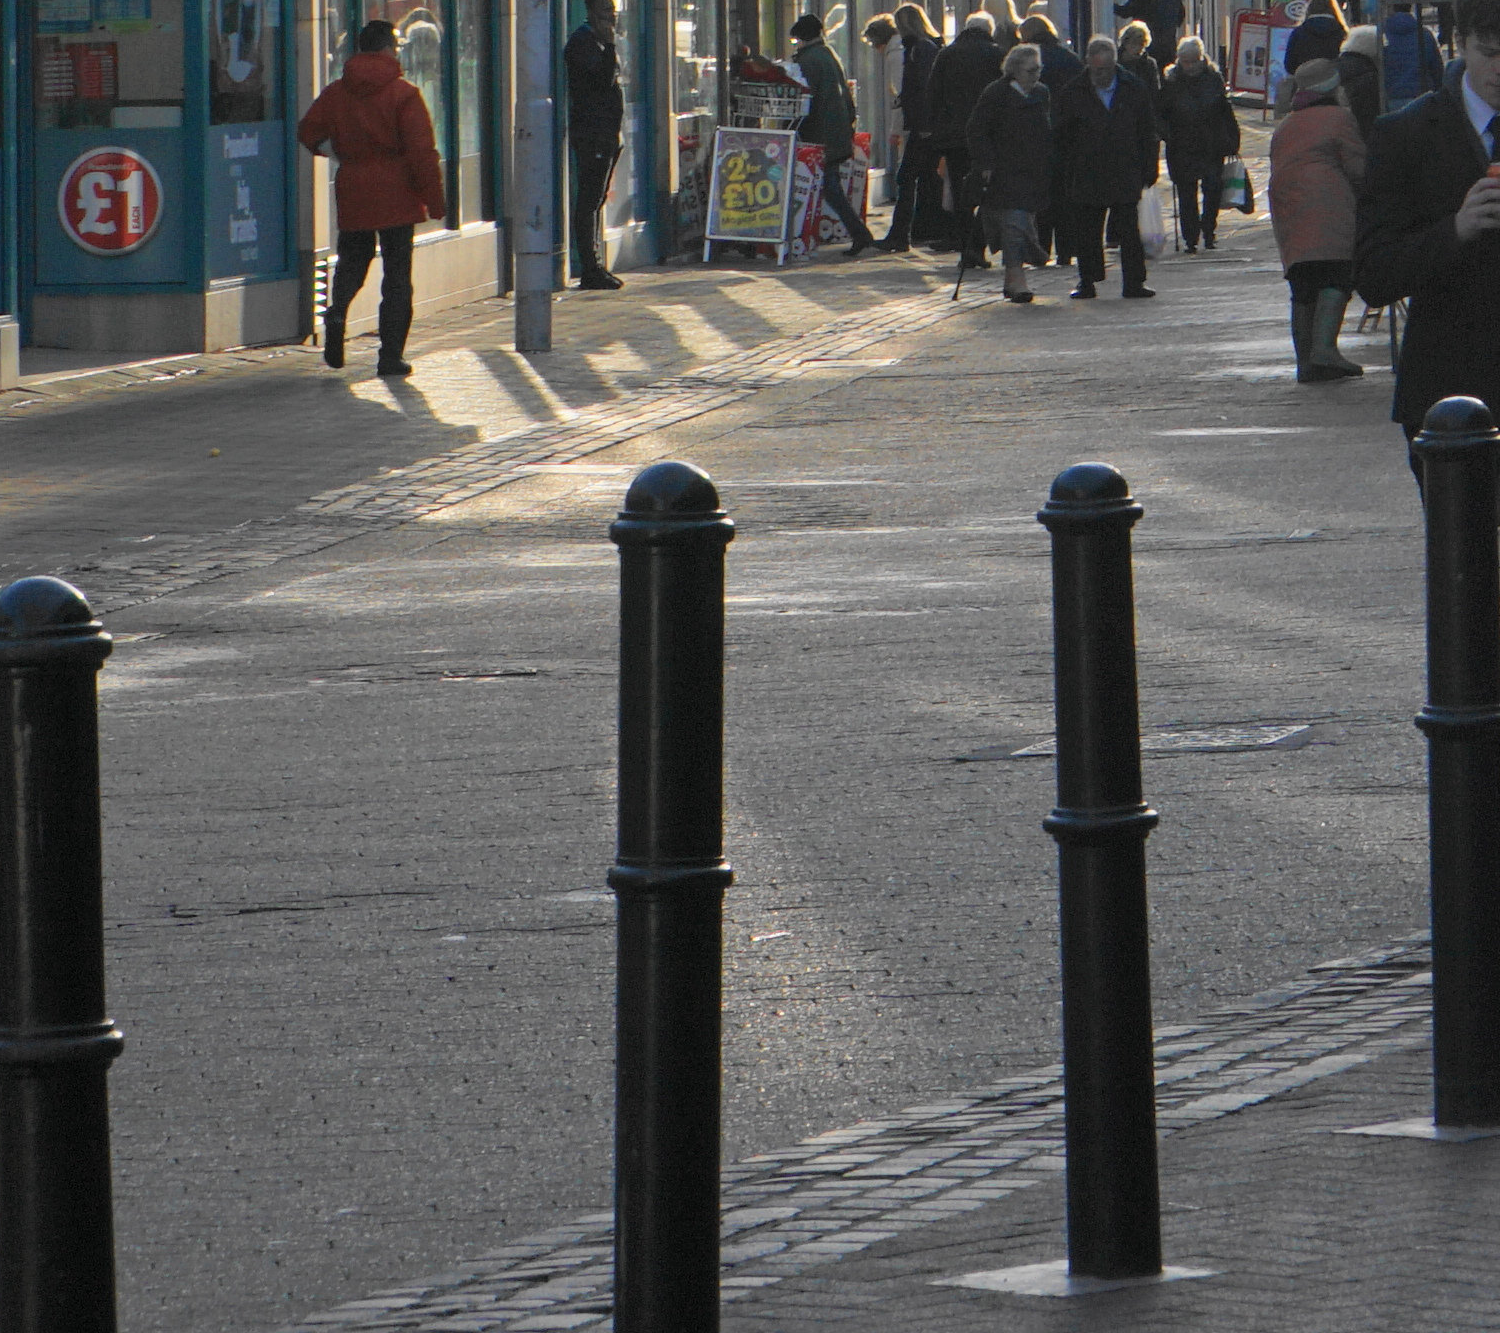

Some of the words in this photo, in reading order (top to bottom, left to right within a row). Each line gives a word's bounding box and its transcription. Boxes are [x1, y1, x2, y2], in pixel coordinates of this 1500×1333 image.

[727, 156, 747, 182] 2
[76, 170, 145, 235] £1
[722, 180, 776, 209] £10
[131, 205, 141, 231] EACH
